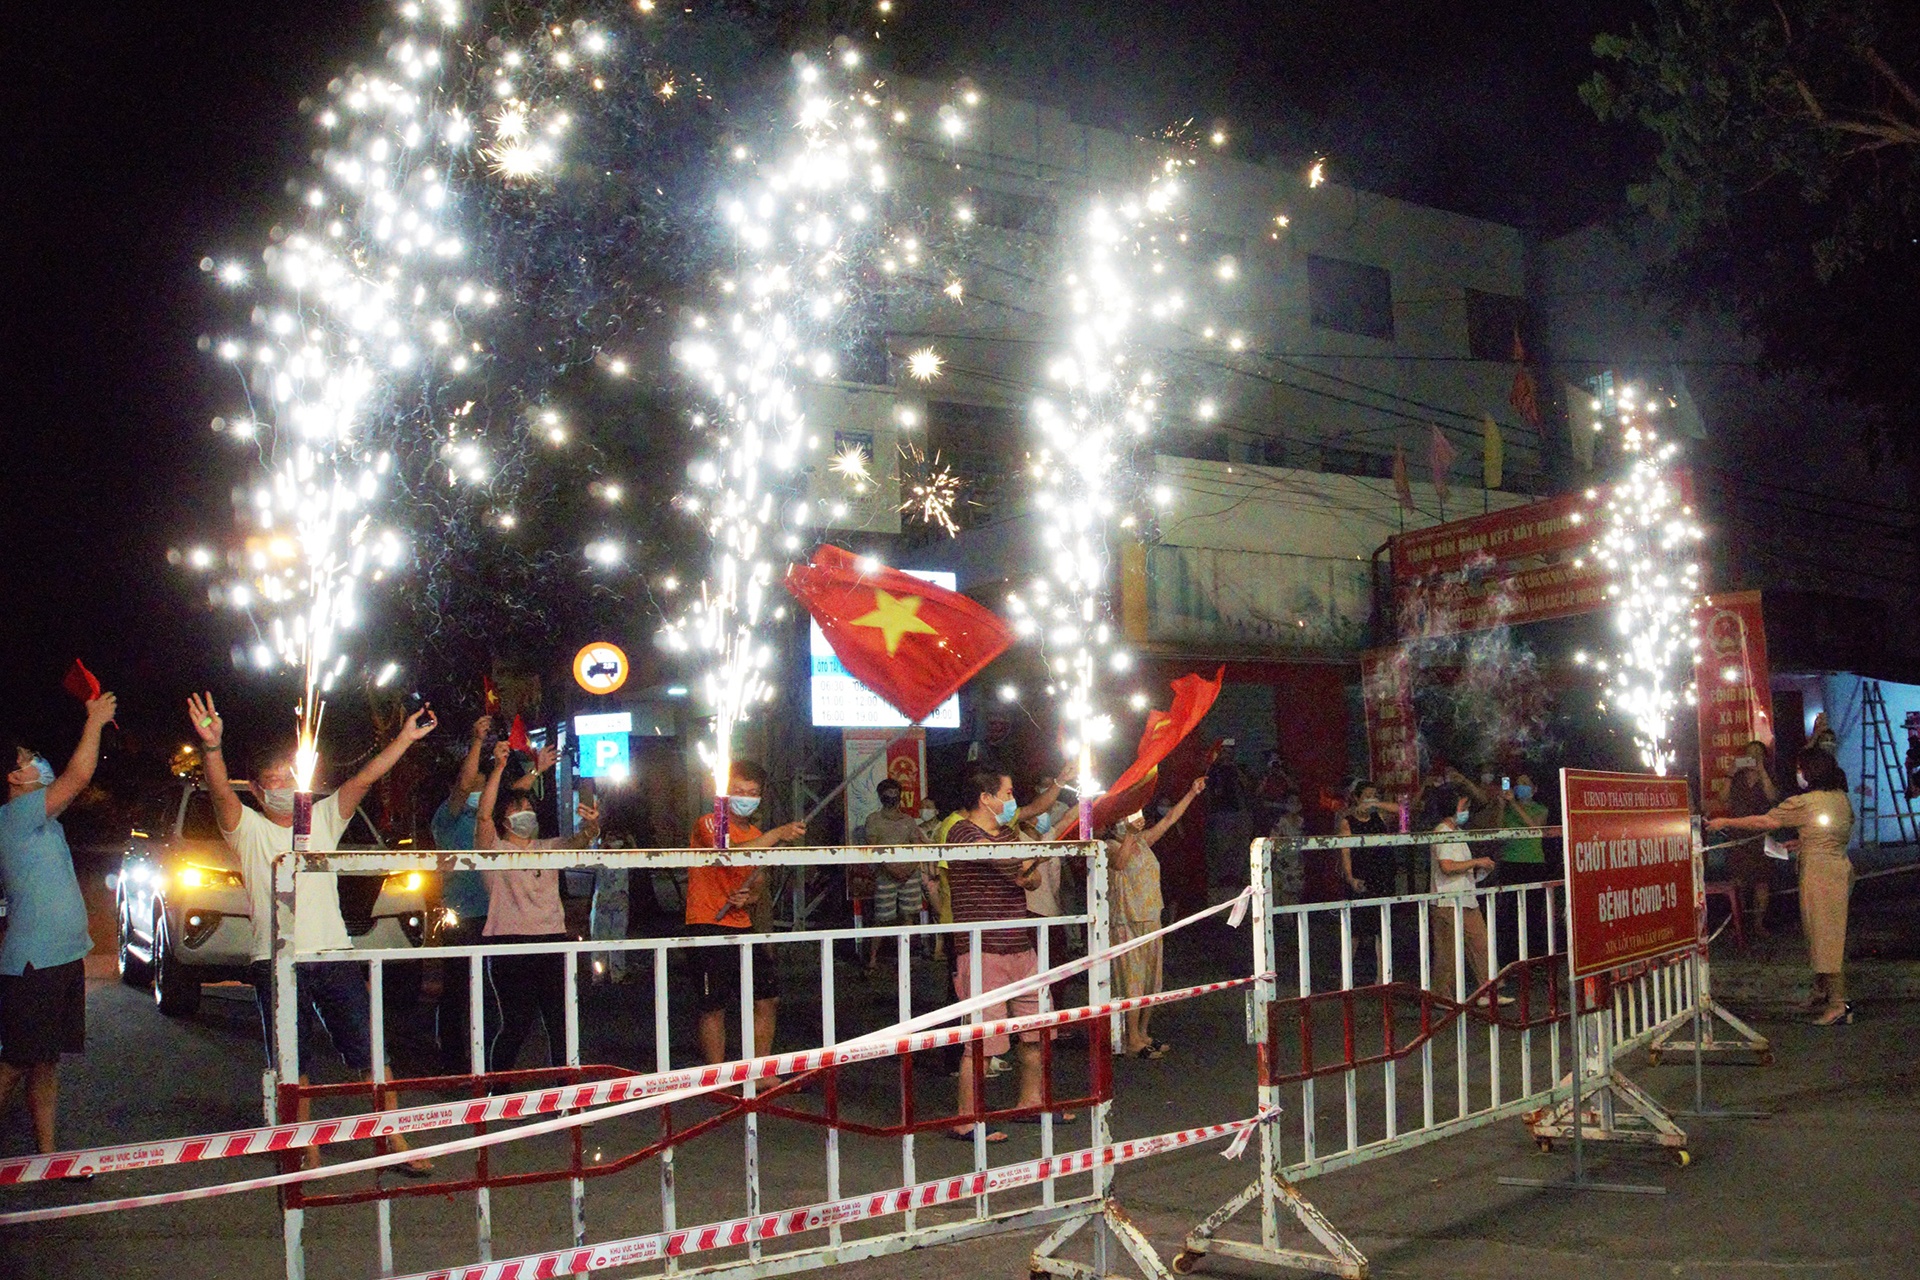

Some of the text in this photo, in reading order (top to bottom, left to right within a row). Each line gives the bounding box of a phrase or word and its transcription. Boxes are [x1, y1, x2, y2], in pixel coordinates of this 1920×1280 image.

[597, 740, 619, 767] P
[1584, 791, 1607, 807] UBND
[1575, 831, 1606, 873] CHỐT
[1609, 827, 1638, 869] KIỂM
[1598, 882, 1678, 927] BỆNH COVID-19
[398, 1115, 411, 1124] KHU
[412, 1121, 437, 1129] ALLOWED
[438, 1118, 452, 1126] AREA
[100, 1154, 114, 1164] KHU
[621, 1252, 643, 1260] ALLOWED
